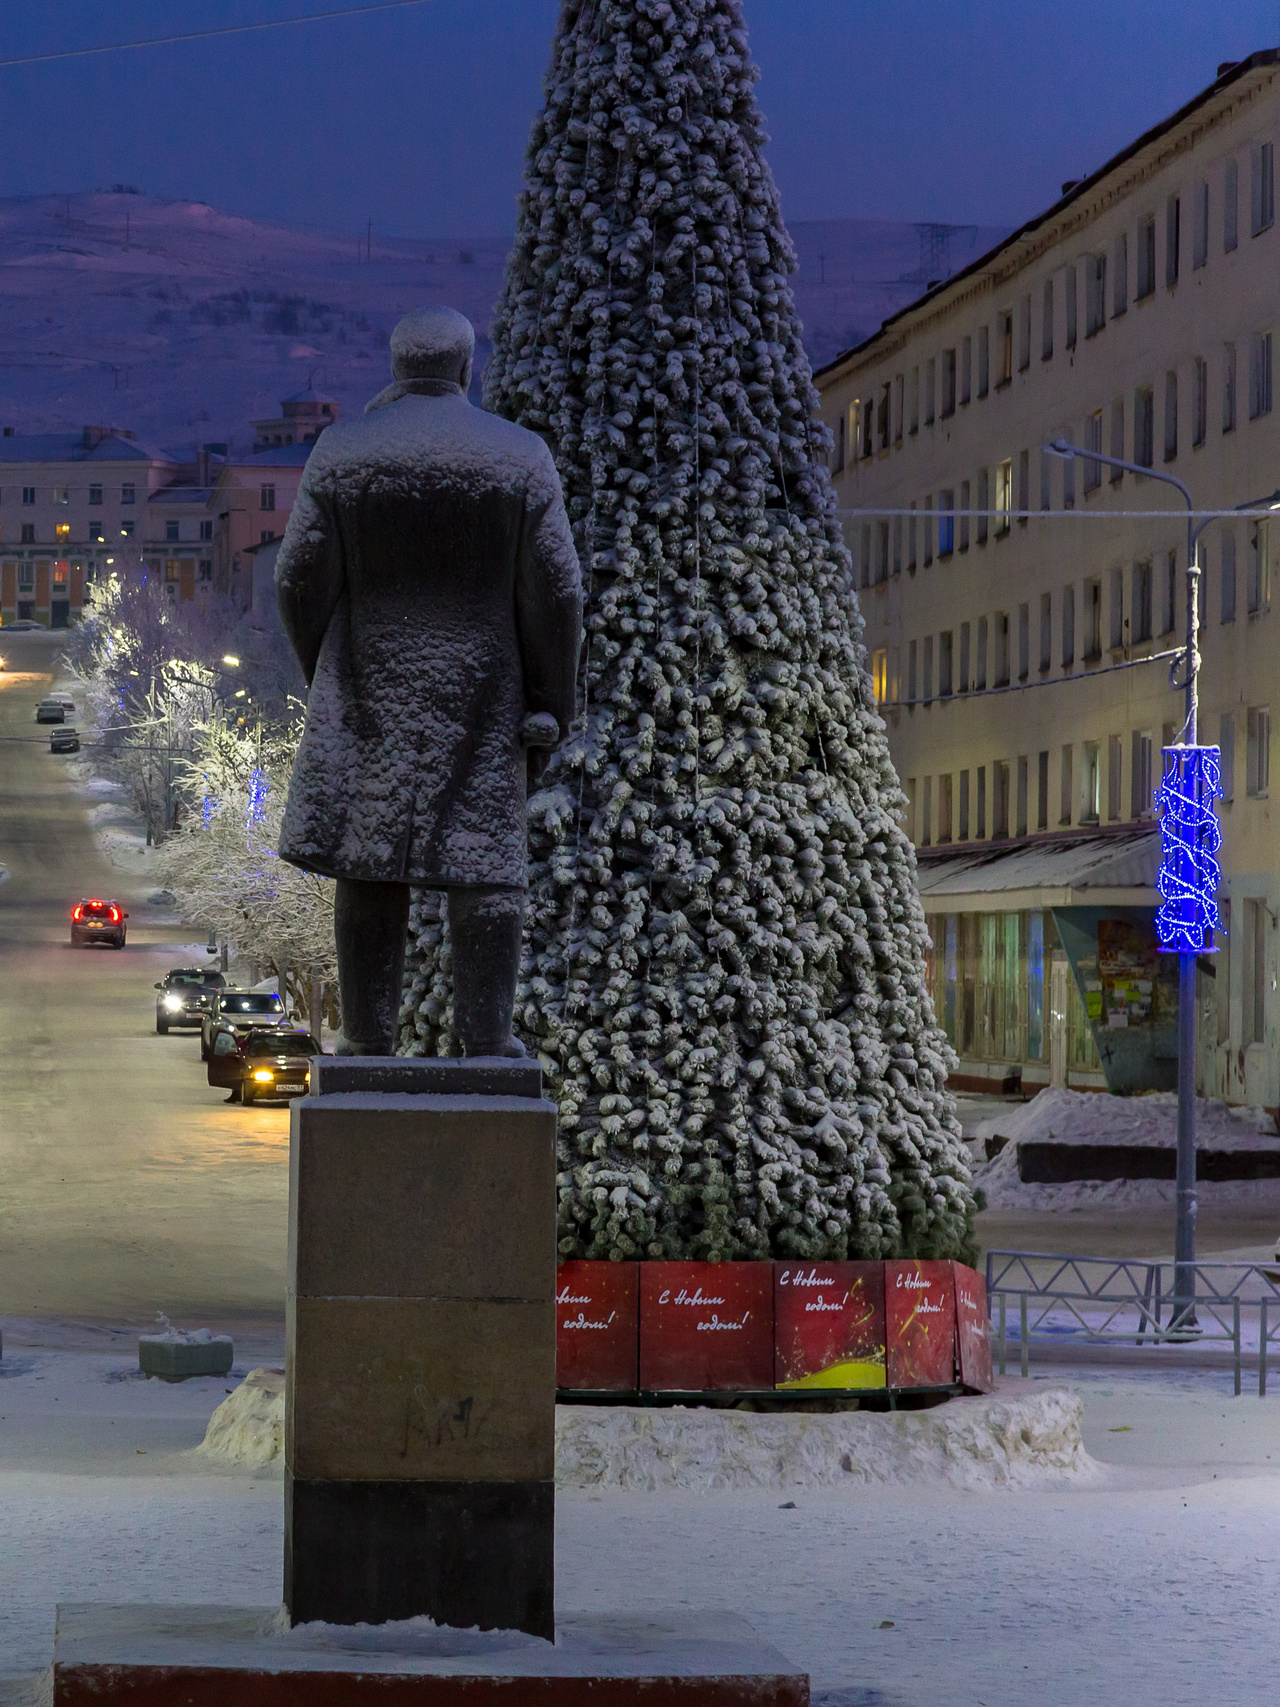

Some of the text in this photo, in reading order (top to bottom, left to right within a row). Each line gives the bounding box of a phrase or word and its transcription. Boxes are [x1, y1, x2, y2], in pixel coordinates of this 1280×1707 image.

[779, 1268, 835, 1287] С Новым
[896, 1270, 932, 1289] С Новым
[556, 1286, 592, 1304] вым
[658, 1287, 726, 1306] С Новым
[805, 1291, 849, 1311] годом!
[916, 1293, 945, 1313] годом!
[563, 1310, 616, 1329] годом!
[696, 1310, 750, 1330] годом!
